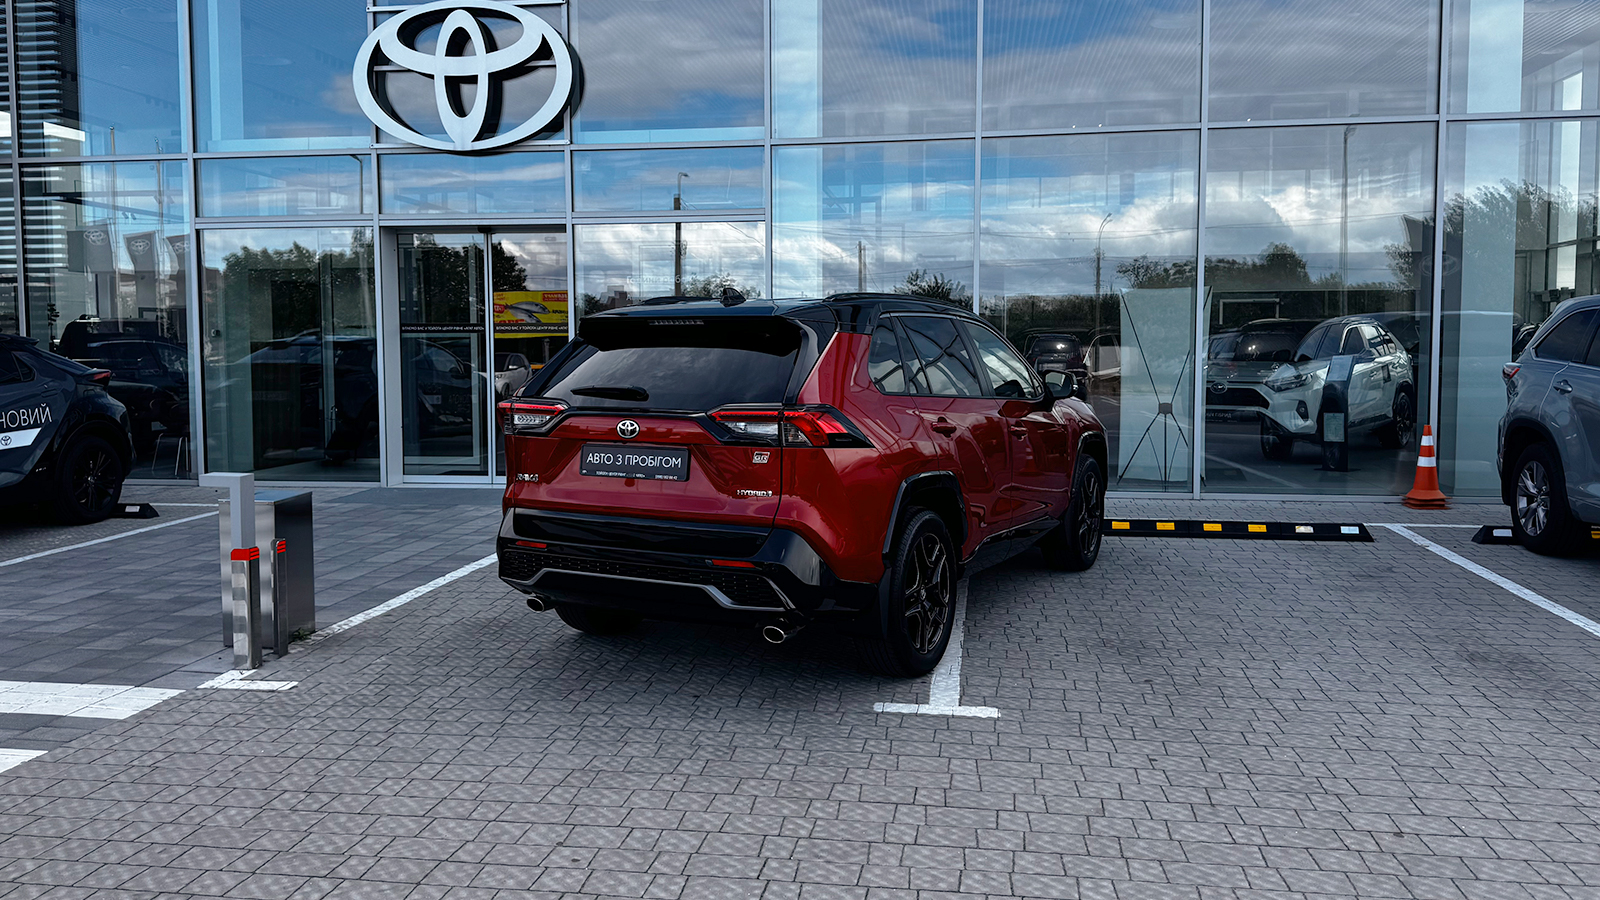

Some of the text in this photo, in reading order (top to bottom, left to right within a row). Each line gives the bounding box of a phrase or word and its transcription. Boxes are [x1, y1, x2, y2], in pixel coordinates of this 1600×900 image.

[0, 403, 52, 429] НОВИЙ
[586, 453, 614, 465] АВТО
[624, 454, 682, 469] ПРОБІГОМ
